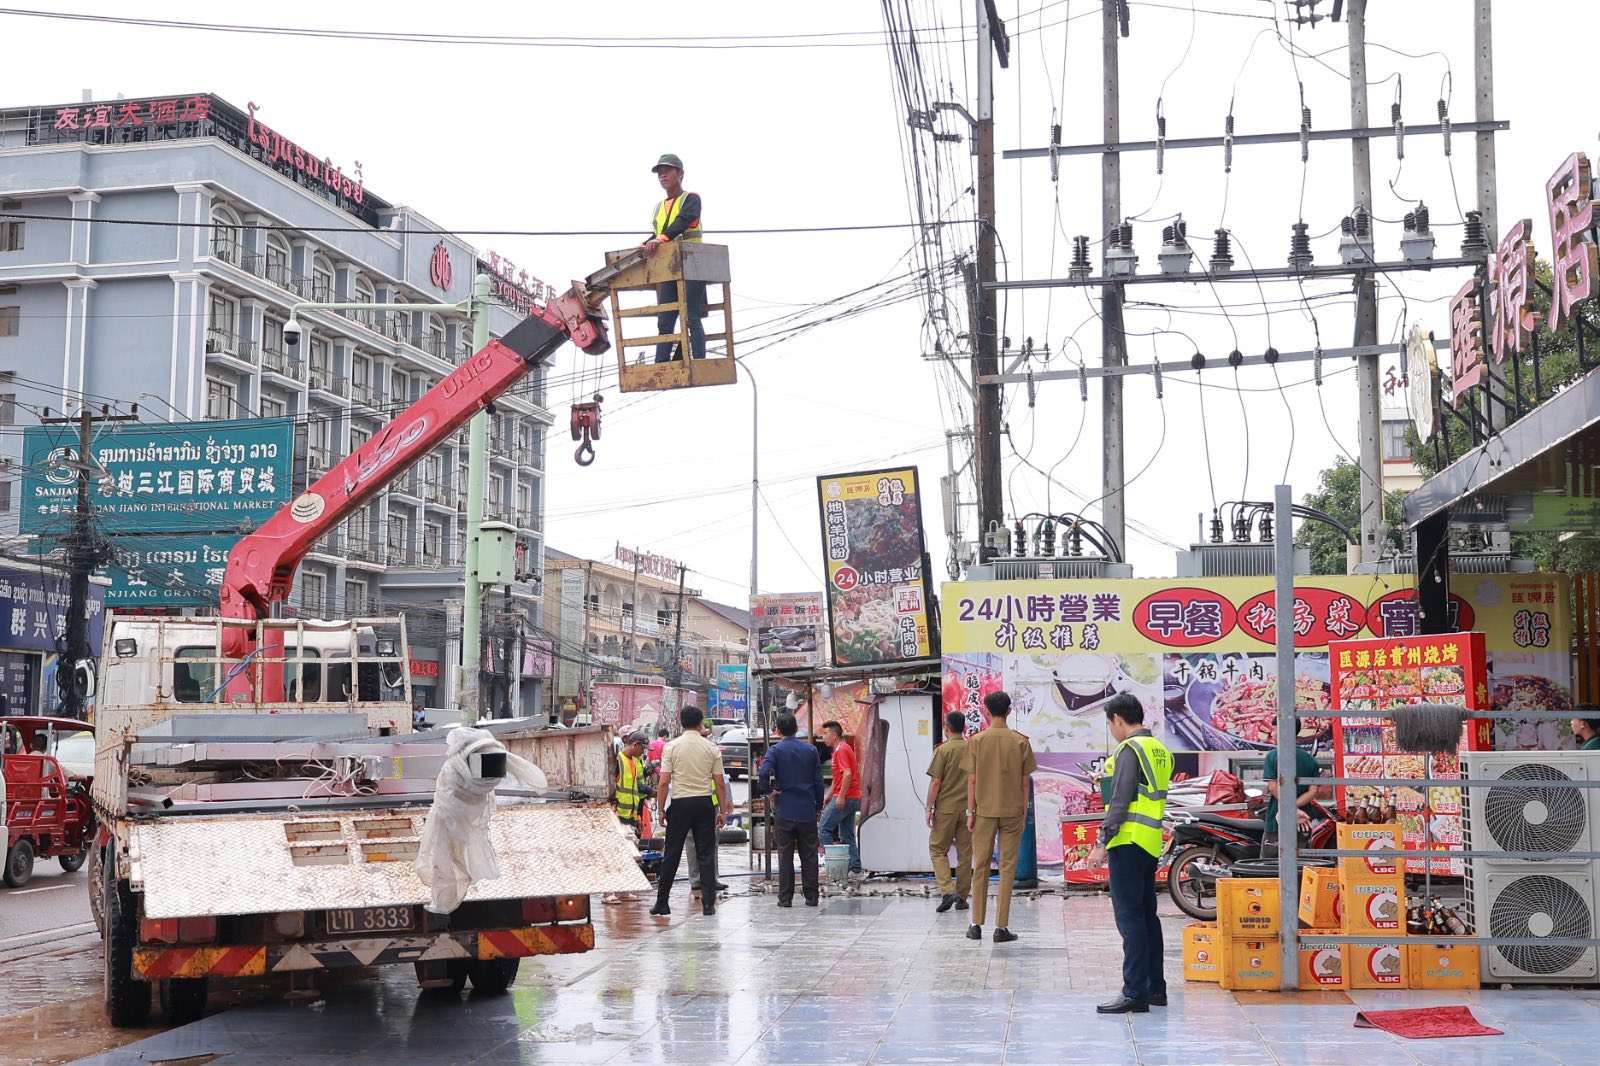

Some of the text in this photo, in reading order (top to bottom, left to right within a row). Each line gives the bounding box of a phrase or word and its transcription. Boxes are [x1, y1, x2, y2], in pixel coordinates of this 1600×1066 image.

[54, 96, 211, 130] 友谊大酒店
[440, 352, 493, 400] UNIC
[37, 503, 78, 515] 老挝三
[119, 503, 148, 513] JIANG
[233, 500, 275, 510] MARKET
[827, 500, 847, 560] 地标羊肉粉
[104, 589, 157, 598] NJIANG
[958, 593, 1121, 624] 24小時營業
[1147, 600, 1223, 638] 早餐
[901, 617, 917, 656] 牛肉粉
[995, 622, 1102, 652] 升级推荐
[1172, 660, 1266, 683] 干锅牛肉
[1374, 866, 1396, 874] LBC
[363, 906, 411, 929] 3333
[1376, 921, 1399, 929] LBC
[1320, 976, 1343, 984] LBC
